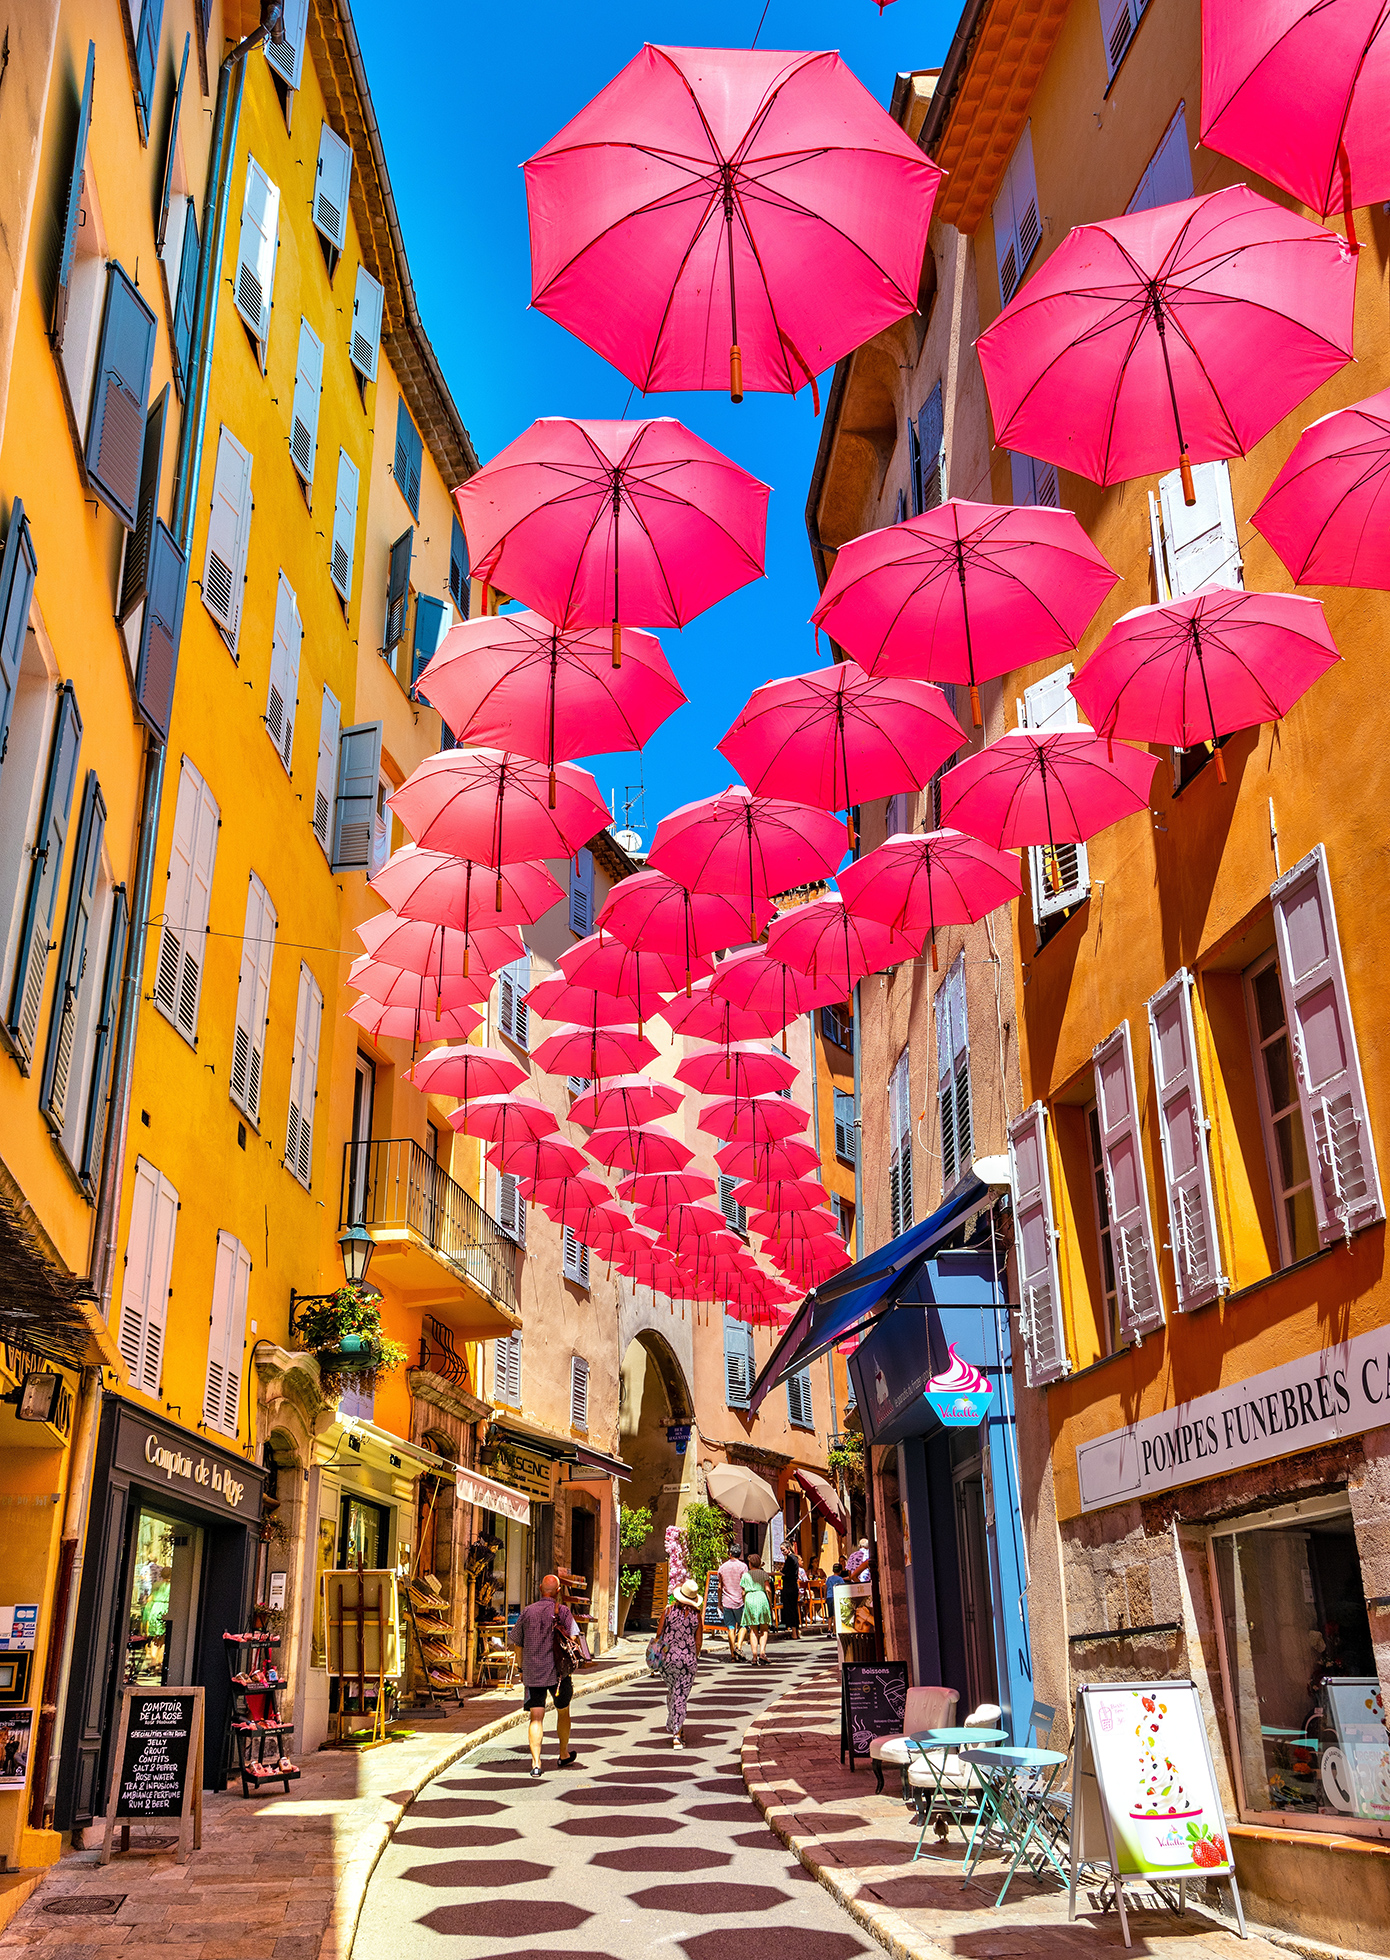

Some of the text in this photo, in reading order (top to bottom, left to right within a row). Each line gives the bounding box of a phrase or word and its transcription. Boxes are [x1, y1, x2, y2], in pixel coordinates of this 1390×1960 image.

[937, 1403, 980, 1419] Valalla
[1141, 1352, 1390, 1477] POMPES FUNEBRES C
[145, 1434, 245, 1507] Comptoir de la Rose
[861, 1667, 890, 1675] Boissons
[142, 1699, 182, 1712] COMPTOIR
[139, 1711, 183, 1721] DE LA ROSE
[138, 1754, 170, 1763] CONFITS
[132, 1763, 149, 1772] SALT
[156, 1763, 178, 1771] PEPPER
[135, 1772, 175, 1781] ROSE WATER
[124, 1782, 138, 1790] TEA
[145, 1780, 179, 1790] INFUSIONS
[121, 1790, 181, 1799] AMBIANCE PERFUME
[128, 1800, 144, 1808] RUM
[151, 1800, 170, 1808] BEER
[1156, 1836, 1185, 1848] Valalla
